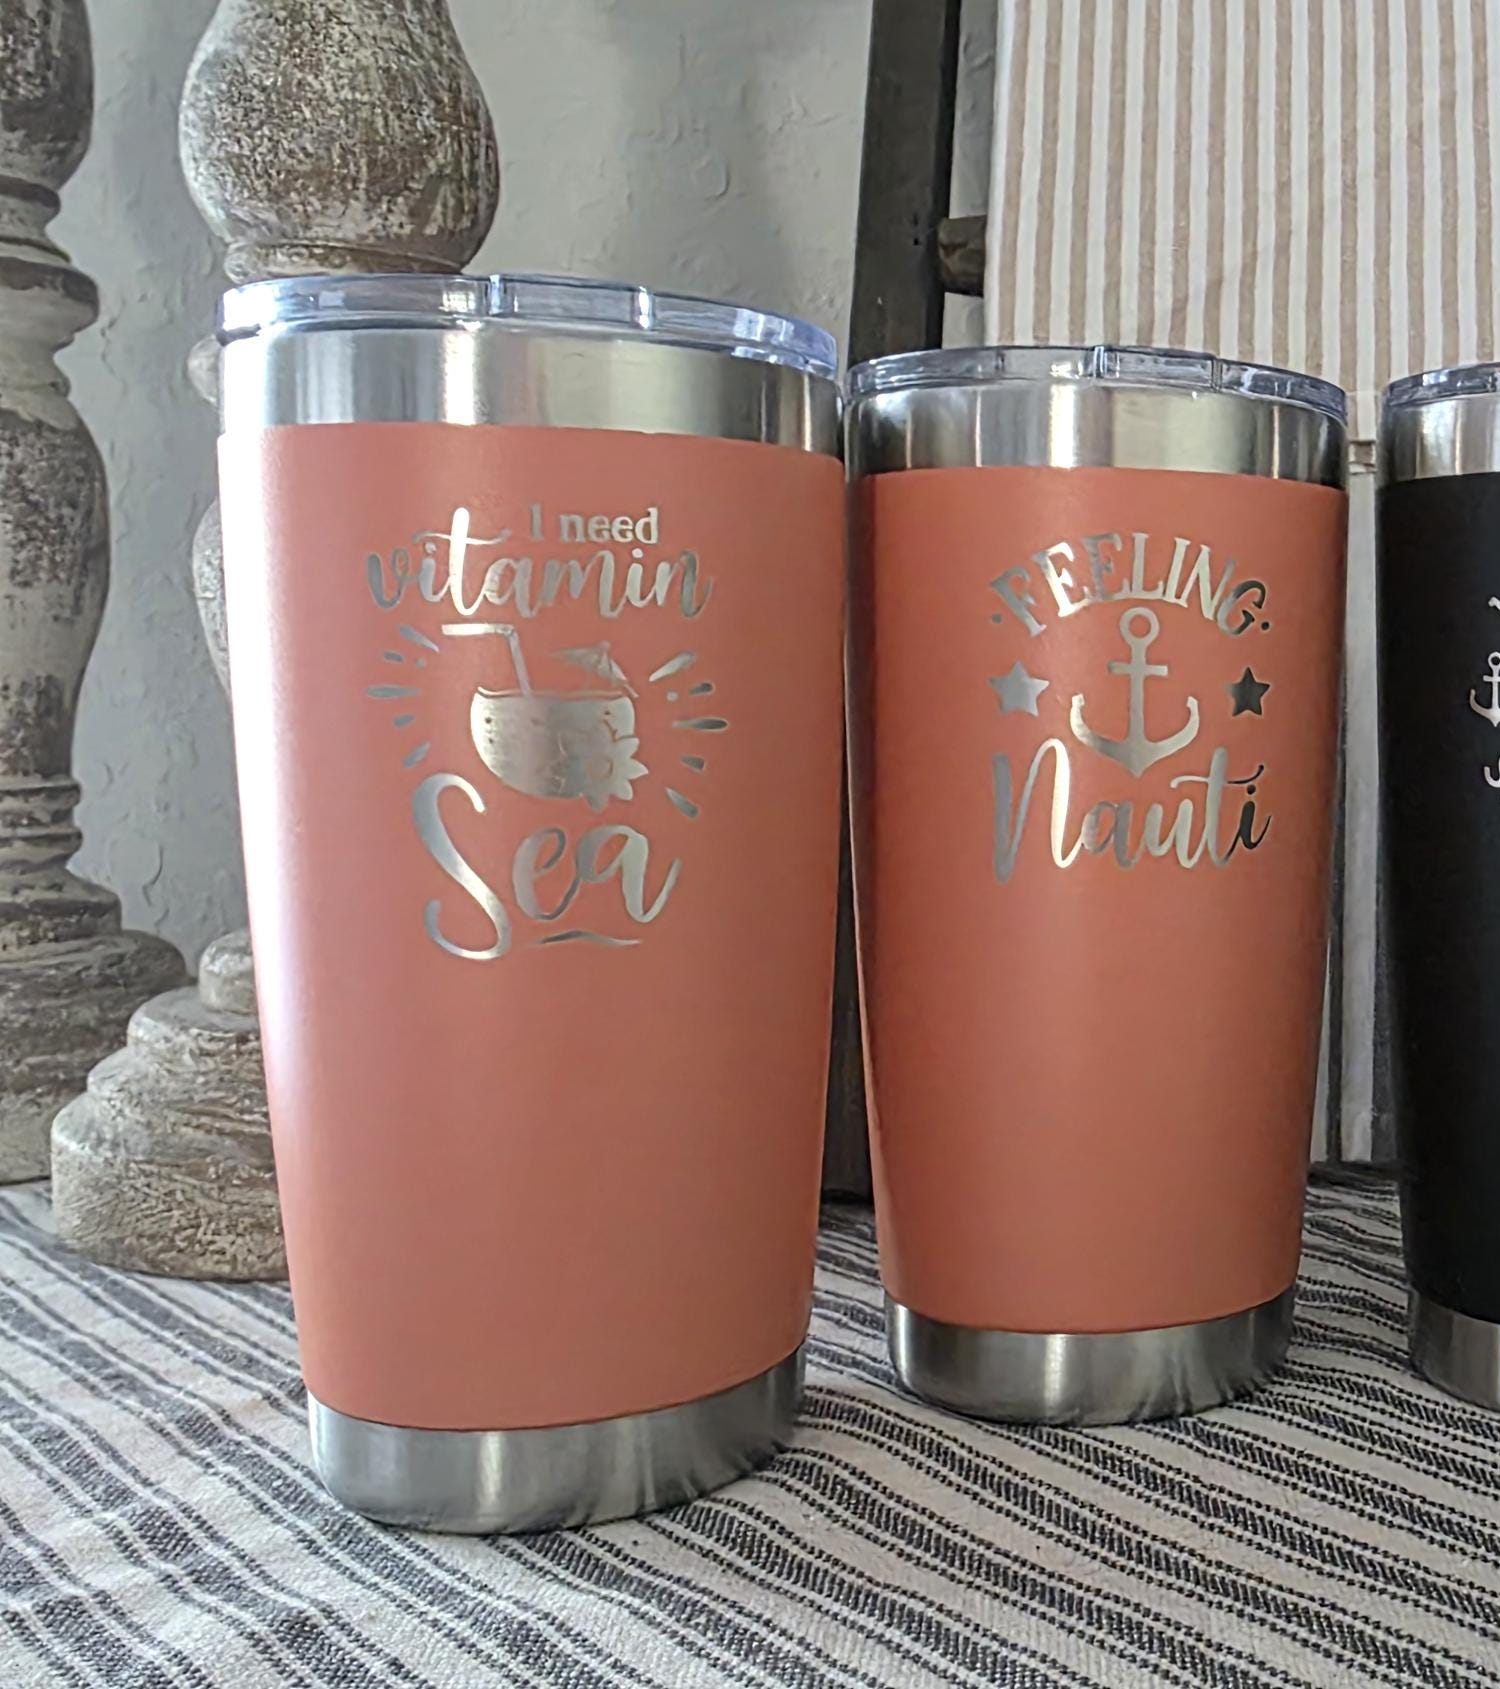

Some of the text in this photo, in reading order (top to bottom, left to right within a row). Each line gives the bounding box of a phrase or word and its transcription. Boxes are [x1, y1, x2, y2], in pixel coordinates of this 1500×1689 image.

[366, 507, 714, 618] vitamin
[530, 504, 660, 544] I need
[989, 533, 1268, 636] FEELING
[991, 737, 1272, 884] Nauti
[411, 772, 683, 961] Sea
